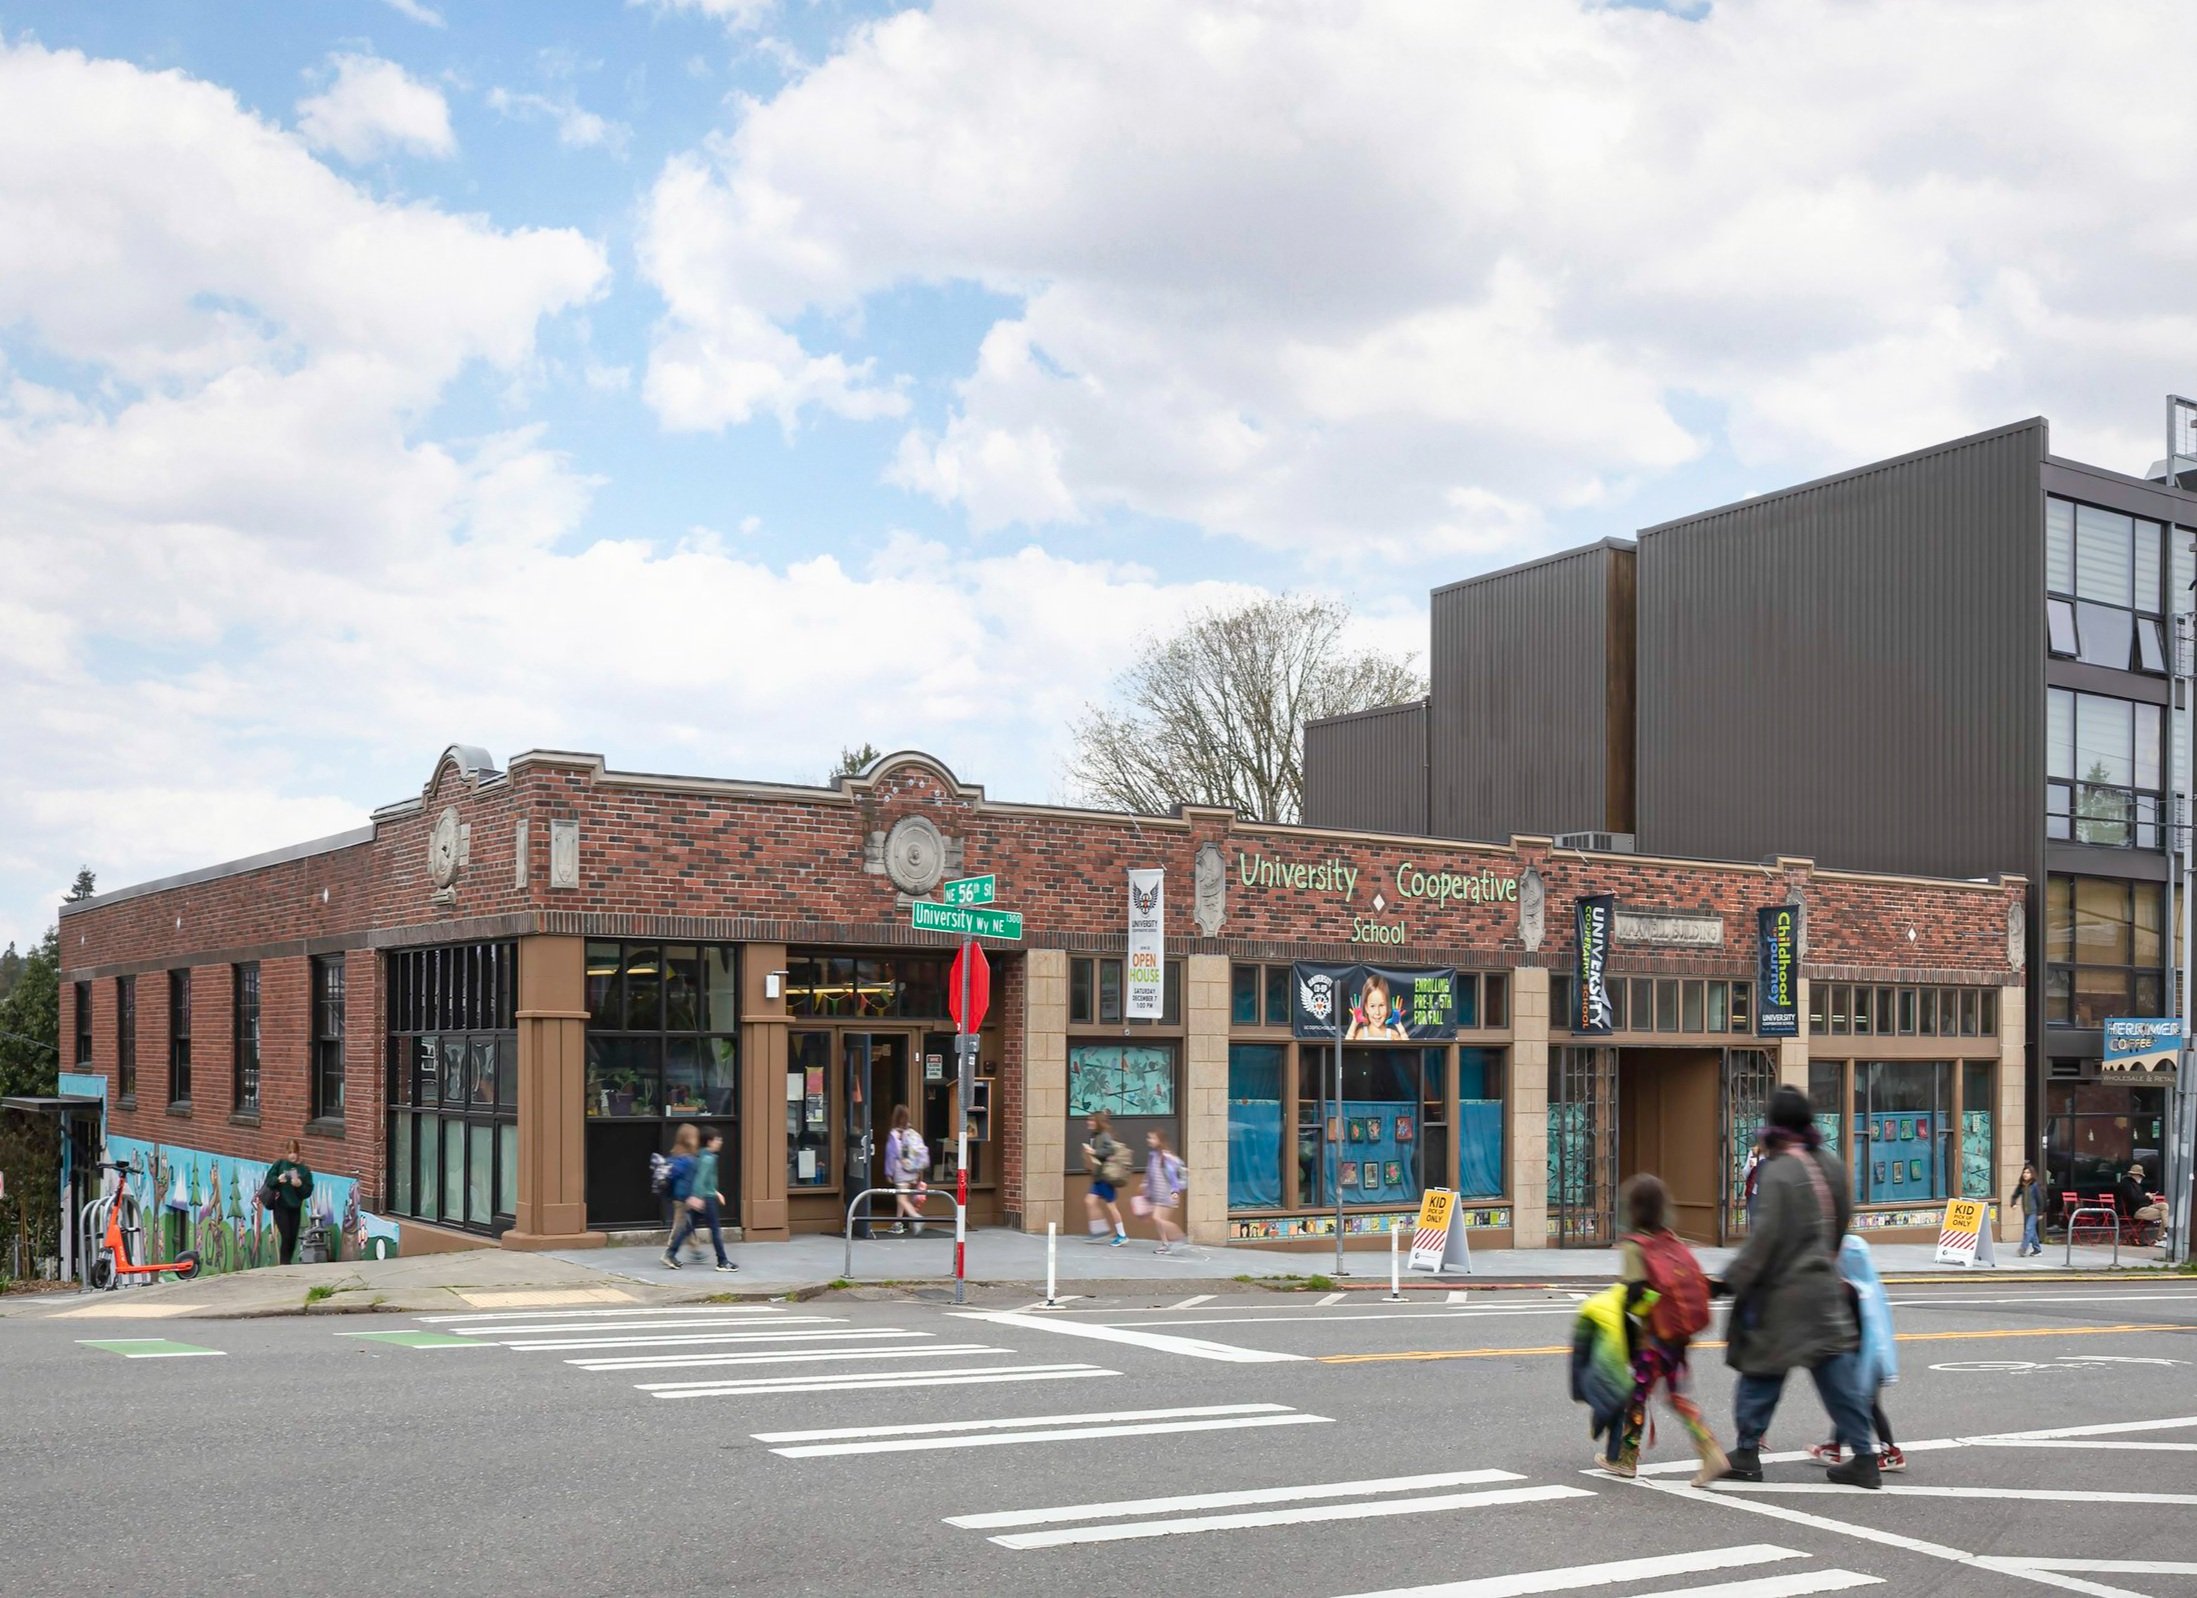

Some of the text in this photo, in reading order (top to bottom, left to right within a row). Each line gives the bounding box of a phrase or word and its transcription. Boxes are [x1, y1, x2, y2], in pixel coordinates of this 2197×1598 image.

[1240, 853, 1518, 909] University Cooperative
[946, 888, 956, 902] NE
[984, 882, 993, 897] St
[915, 903, 974, 933] University
[976, 916, 989, 934] Wy
[992, 919, 1005, 933] NE
[1131, 920, 1158, 928] UNIVERSITY
[1352, 916, 1406, 945] School
[1671, 920, 1718, 943] BUILDING
[1132, 953, 1157, 967] OPEN
[1777, 911, 1792, 1006] Childhood
[1582, 905, 1592, 1029] COOPERATIVE SCHOOL
[1588, 906, 1606, 1030] UNIVERSITY
[1129, 968, 1160, 982] HOUSE
[1414, 977, 1450, 993] ENROLLING
[1438, 994, 1452, 1009] 5TH
[1413, 1010, 1444, 1025] FOR FALL
[1762, 1013, 1796, 1022] UNIVERSITY
[2109, 1038, 2154, 1052] COFFEE
[2103, 1074, 2145, 1083] WHOLESALE
[1429, 1196, 1447, 1209] KID
[1954, 1204, 1975, 1216] KID
[1426, 1214, 1443, 1223] ONLY
[1952, 1219, 1971, 1227] ONLY
